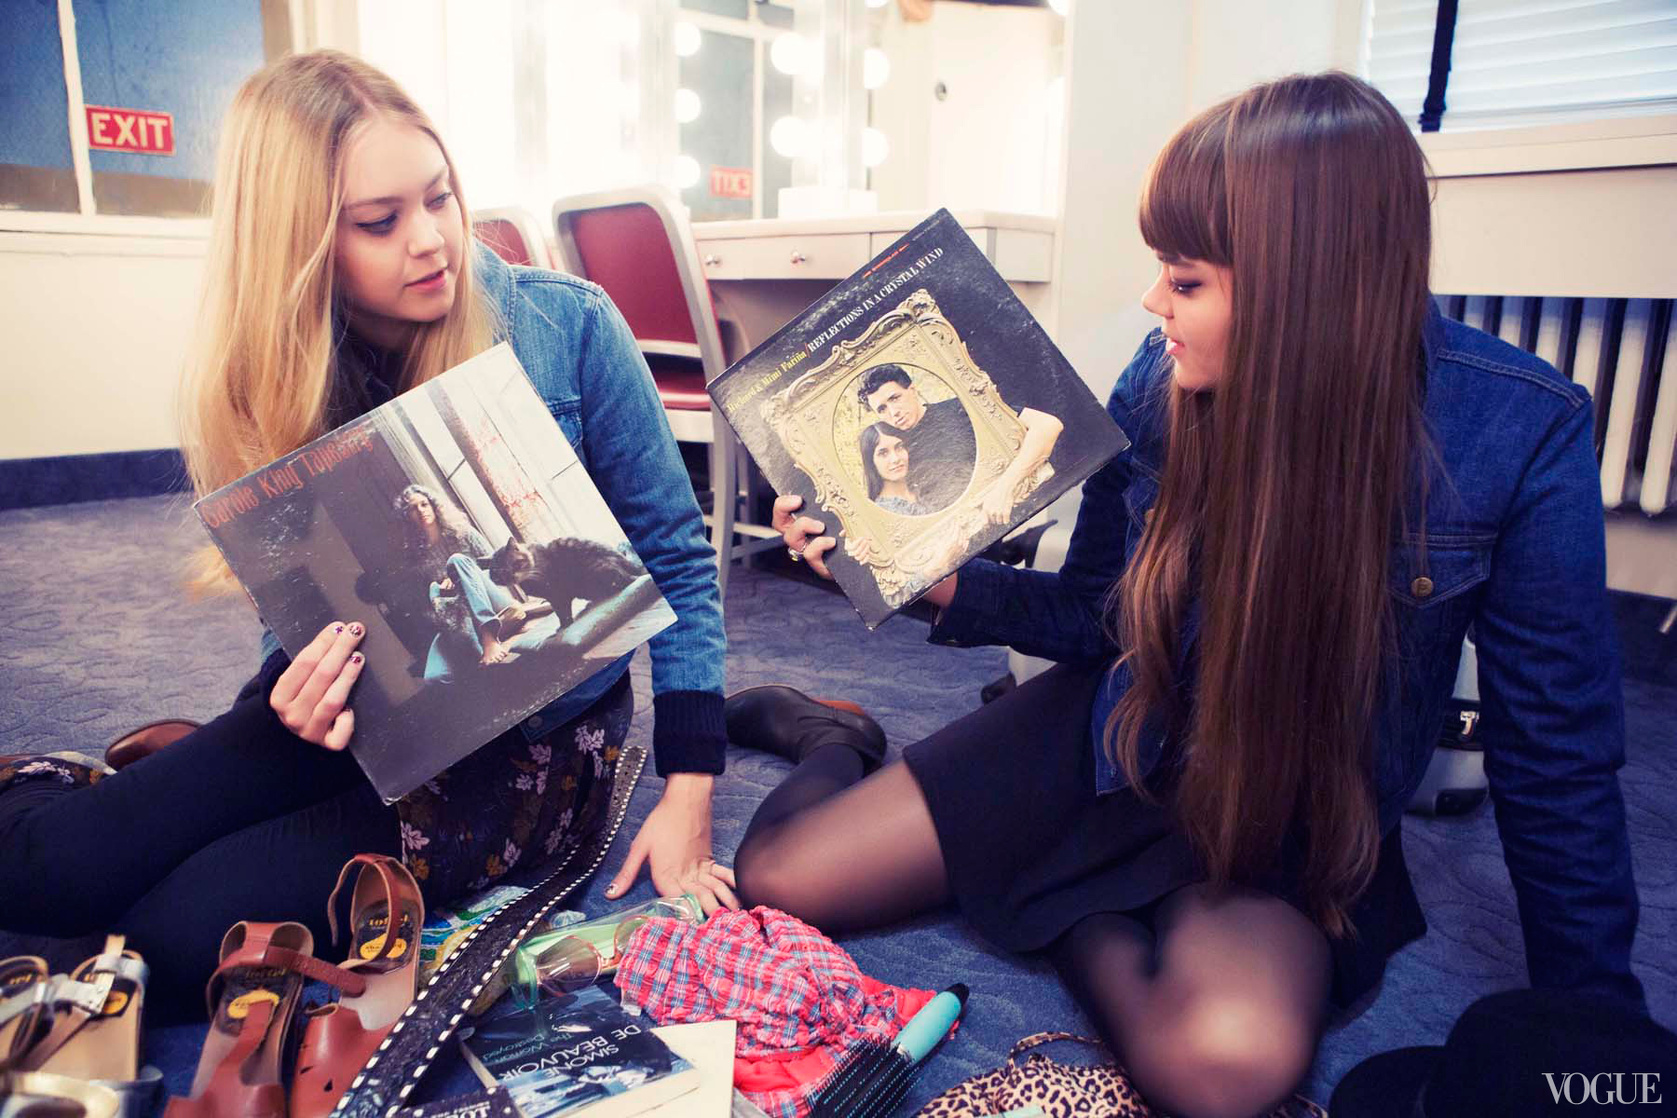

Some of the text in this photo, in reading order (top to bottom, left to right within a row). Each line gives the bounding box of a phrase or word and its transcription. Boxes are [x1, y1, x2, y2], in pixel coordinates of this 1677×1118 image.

[91, 112, 168, 149] EXIT
[761, 368, 782, 387] Mimi
[807, 305, 865, 353] REFLECTIONS
[862, 298, 876, 311] IN
[874, 293, 884, 303] A
[880, 266, 919, 301] CRYSTAL
[915, 247, 944, 271] WIND
[256, 464, 304, 499] King
[499, 1025, 642, 1081] DE BEAUVOIR
[545, 1044, 620, 1079] SIMONE
